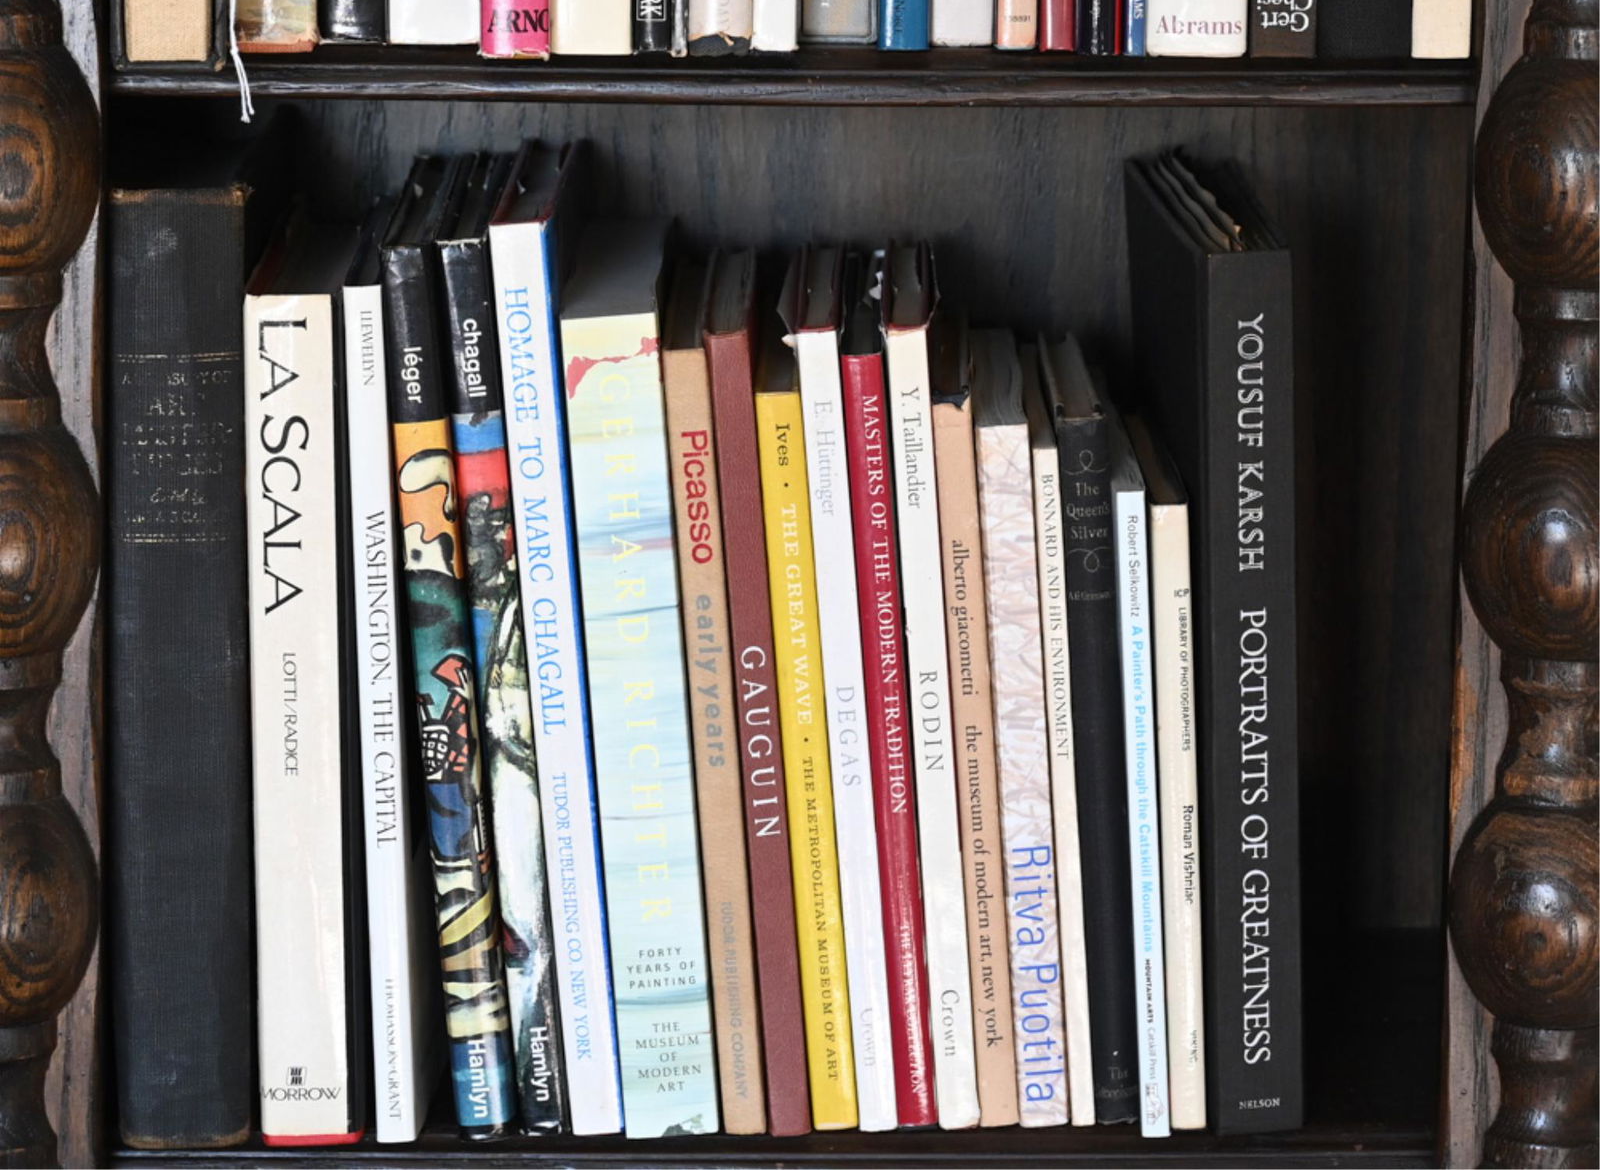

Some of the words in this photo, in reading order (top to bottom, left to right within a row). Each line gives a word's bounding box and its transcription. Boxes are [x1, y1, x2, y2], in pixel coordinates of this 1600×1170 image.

[1156, 16, 1242, 34] Abrams
[1261, 13, 1309, 32] Gert
[257, 317, 306, 401] LA
[504, 287, 539, 422] HOMAGE
[1237, 314, 1264, 447] YOUSUF
[814, 401, 833, 419] E.
[902, 387, 919, 406] Y.
[519, 437, 544, 479] TO
[776, 424, 793, 466] Ives
[816, 430, 838, 516] Hüttinger
[861, 395, 883, 496] MASTERS
[903, 413, 923, 508] Taillandier
[261, 415, 309, 615] SCALA
[681, 431, 715, 564] Picasso
[871, 502, 888, 529] OF
[1041, 474, 1059, 557] BONNARD
[1238, 462, 1264, 572] KARSH
[523, 497, 553, 582] MARC
[782, 504, 801, 557] THE
[873, 537, 892, 582] THE
[1127, 515, 1140, 556] Robert
[951, 540, 973, 601] alberto
[1046, 564, 1060, 599] AND
[1130, 560, 1141, 617] Selkowitz
[695, 594, 723, 671] early
[786, 564, 806, 649] GREAT
[1049, 605, 1064, 631] HIS
[1131, 625, 1146, 637] A
[534, 598, 566, 734] CHAGALL
[598, 374, 650, 643] GERHARD
[624, 681, 672, 921] RICHTER
[878, 591, 899, 684] MODERN
[951, 606, 979, 696] giacometti
[795, 656, 812, 724] WAVE
[1050, 638, 1069, 759] ENVIRONMENT
[1132, 640, 1146, 701] Painter's
[283, 652, 298, 776] LOTTI/RADICE
[372, 698, 393, 743] THE
[403, 347, 423, 404] léger
[465, 1039, 491, 1118] Hamlyn
[461, 318, 485, 398] chagall
[528, 1026, 551, 1101] Hamlyn
[701, 684, 727, 767] years
[837, 686, 860, 787] DEGAS
[919, 671, 945, 772] RODIN
[1135, 706, 1148, 739] Path
[1239, 608, 1268, 805] PORTRAITS
[740, 646, 780, 838] GAUGUIN
[884, 691, 907, 813] TRADITION
[965, 725, 983, 752] the
[1135, 742, 1150, 795] through
[374, 752, 397, 849] CAPITAL
[551, 773, 570, 830] TUDOR
[802, 757, 815, 792] THE
[968, 759, 985, 832] museum
[1137, 799, 1150, 820] the
[1242, 815, 1267, 859] OF
[805, 798, 828, 931] METROPOLITAN
[974, 839, 991, 855] of
[1137, 824, 1153, 877] Catskill
[559, 836, 579, 933] PUBLISHING
[974, 862, 993, 929] modern
[1012, 846, 1052, 946] Ritva
[979, 934, 998, 961] art,
[1141, 881, 1154, 953] Mountains
[627, 963, 670, 975] YEARS
[680, 961, 697, 972] OF
[630, 976, 697, 988] PAINTING
[639, 946, 682, 958] FORTY
[816, 939, 834, 1017] MUSEUM
[1242, 870, 1270, 1065] GREATNESS
[568, 971, 586, 1009] NEW
[982, 966, 998, 1000] new
[574, 1016, 591, 1060] YORK
[636, 1034, 700, 1049] MUSEUM
[652, 1021, 681, 1033] THE
[824, 1022, 835, 1042] OF
[941, 989, 960, 1057] Crown
[981, 1008, 1002, 1047] york
[1020, 964, 1063, 1102] Puotila
[637, 1065, 702, 1080] MODERN
[657, 1081, 684, 1093] ART
[660, 1052, 678, 1062] OF
[825, 1048, 838, 1081] ART
